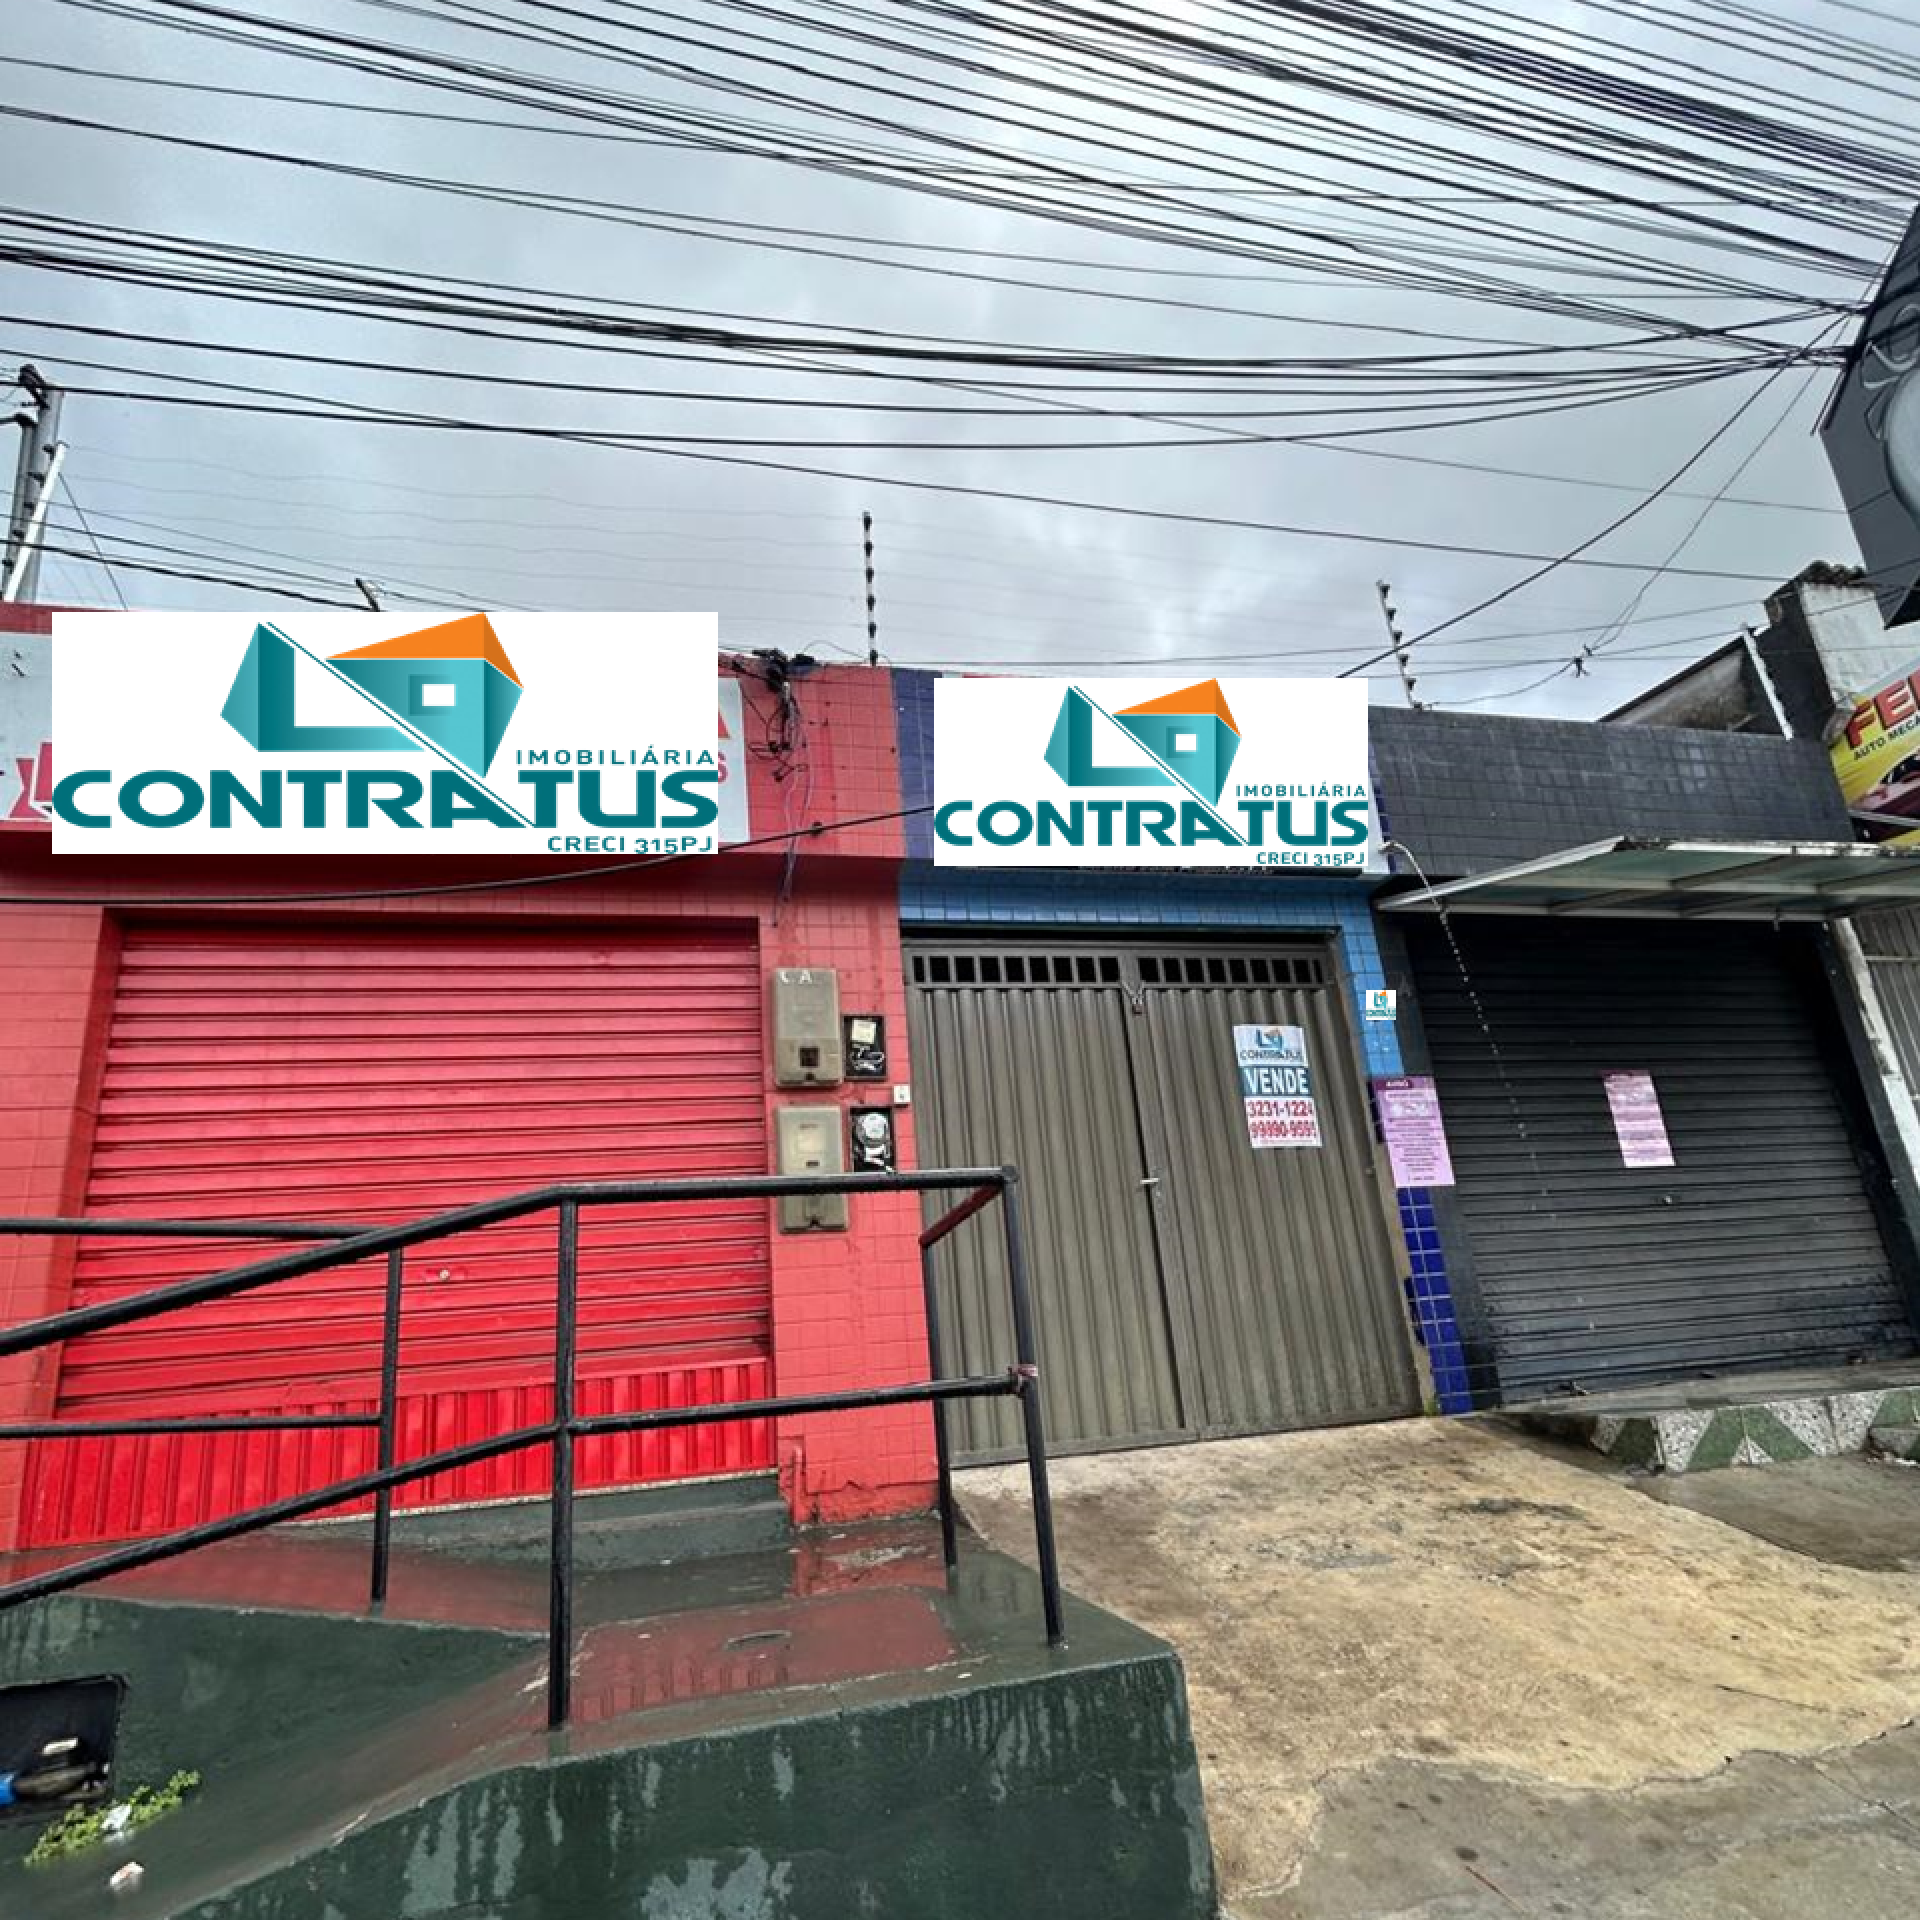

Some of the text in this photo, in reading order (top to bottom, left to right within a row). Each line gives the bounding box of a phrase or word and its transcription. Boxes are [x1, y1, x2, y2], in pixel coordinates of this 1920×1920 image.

[1845, 669, 1920, 749] FE
[1853, 737, 1886, 760] AUTO
[1244, 1067, 1310, 1095] VENDE
